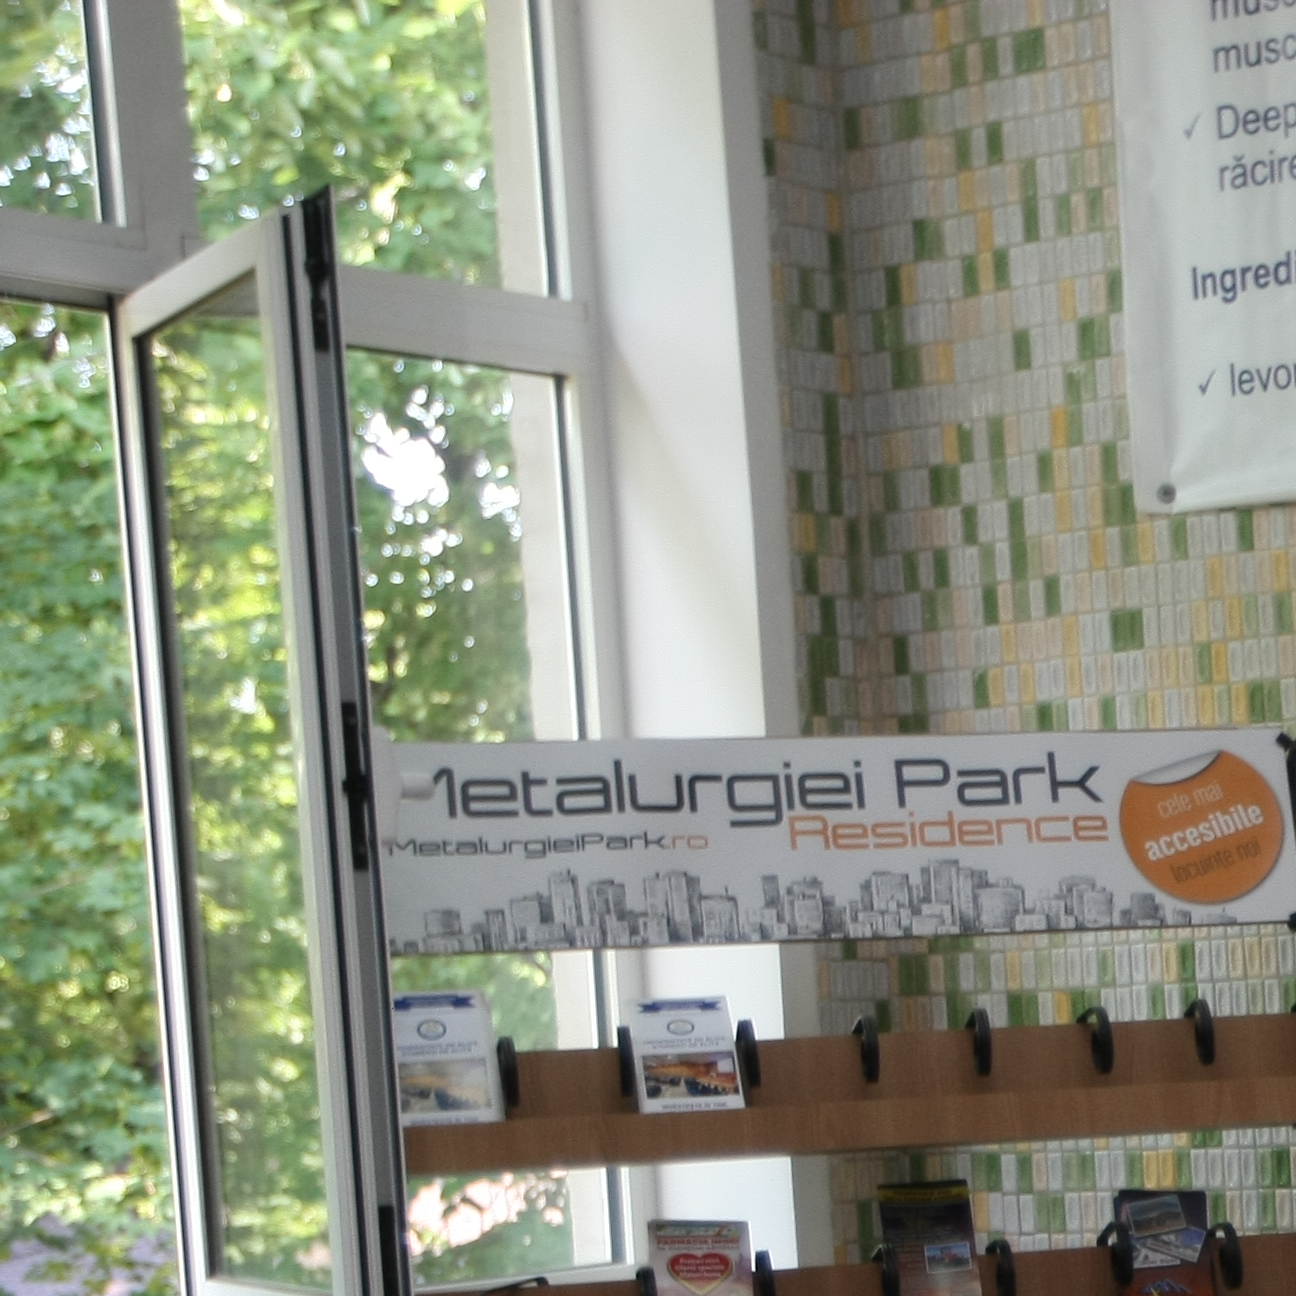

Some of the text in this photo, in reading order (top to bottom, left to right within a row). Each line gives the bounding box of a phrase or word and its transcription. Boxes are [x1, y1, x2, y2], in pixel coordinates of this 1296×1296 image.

[893, 750, 1104, 810] Park
[387, 829, 709, 860] MetalurgieiPark.ro
[787, 810, 1110, 851] Residence
[1144, 803, 1264, 862] accesibile
